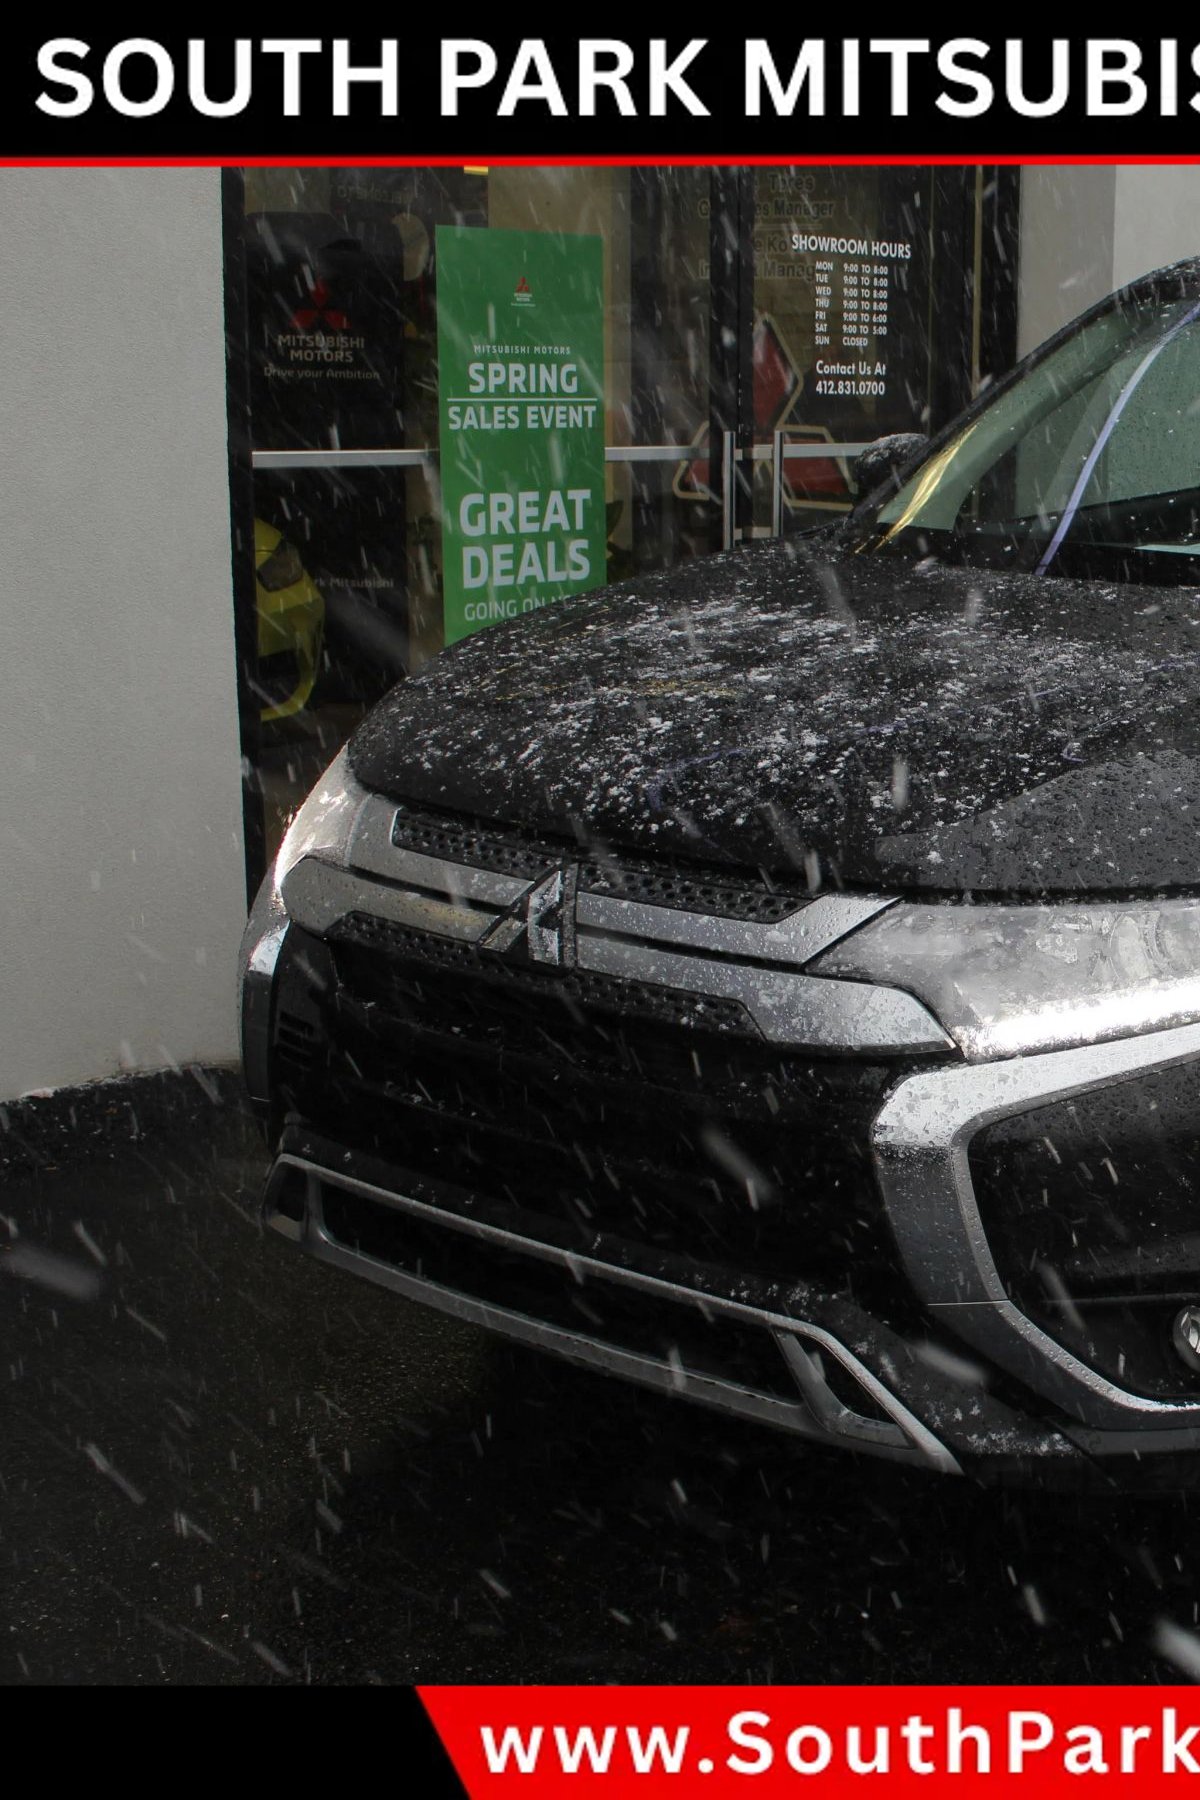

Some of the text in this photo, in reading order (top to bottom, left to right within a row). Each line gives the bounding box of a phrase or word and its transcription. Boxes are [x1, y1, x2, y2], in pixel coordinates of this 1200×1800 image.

[792, 234, 868, 256] SHOWROOM
[871, 242, 911, 259] HOURS
[815, 261, 888, 275] MON 9:00 TO 8:00
[815, 273, 888, 287] TUE 9:00 TO 8:00
[815, 286, 888, 299] WED 9:00 TO 8:00
[815, 298, 888, 311] THU 9:00 TO 8:00
[815, 311, 826, 320] FRI
[843, 312, 858, 321] 9:00
[861, 313, 870, 322] TO
[815, 323, 828, 333] SAT
[842, 324, 857, 334] 9:00
[859, 325, 869, 334] TO
[277, 334, 365, 349] MITSUBISHI
[815, 335, 868, 346] SUN CLOSED
[290, 350, 354, 363] MOTORS
[474, 344, 571, 355] MITSUBISHI MOTORS
[264, 366, 380, 380] Drive your Ambition
[816, 360, 886, 376] Contact Us At
[468, 362, 578, 394] SPRING
[816, 381, 885, 396] 412.831.0700
[448, 404, 597, 430] SALES EVENT
[459, 489, 592, 537] GREAT
[462, 539, 591, 589] DEALS
[464, 599, 517, 621] GOING
